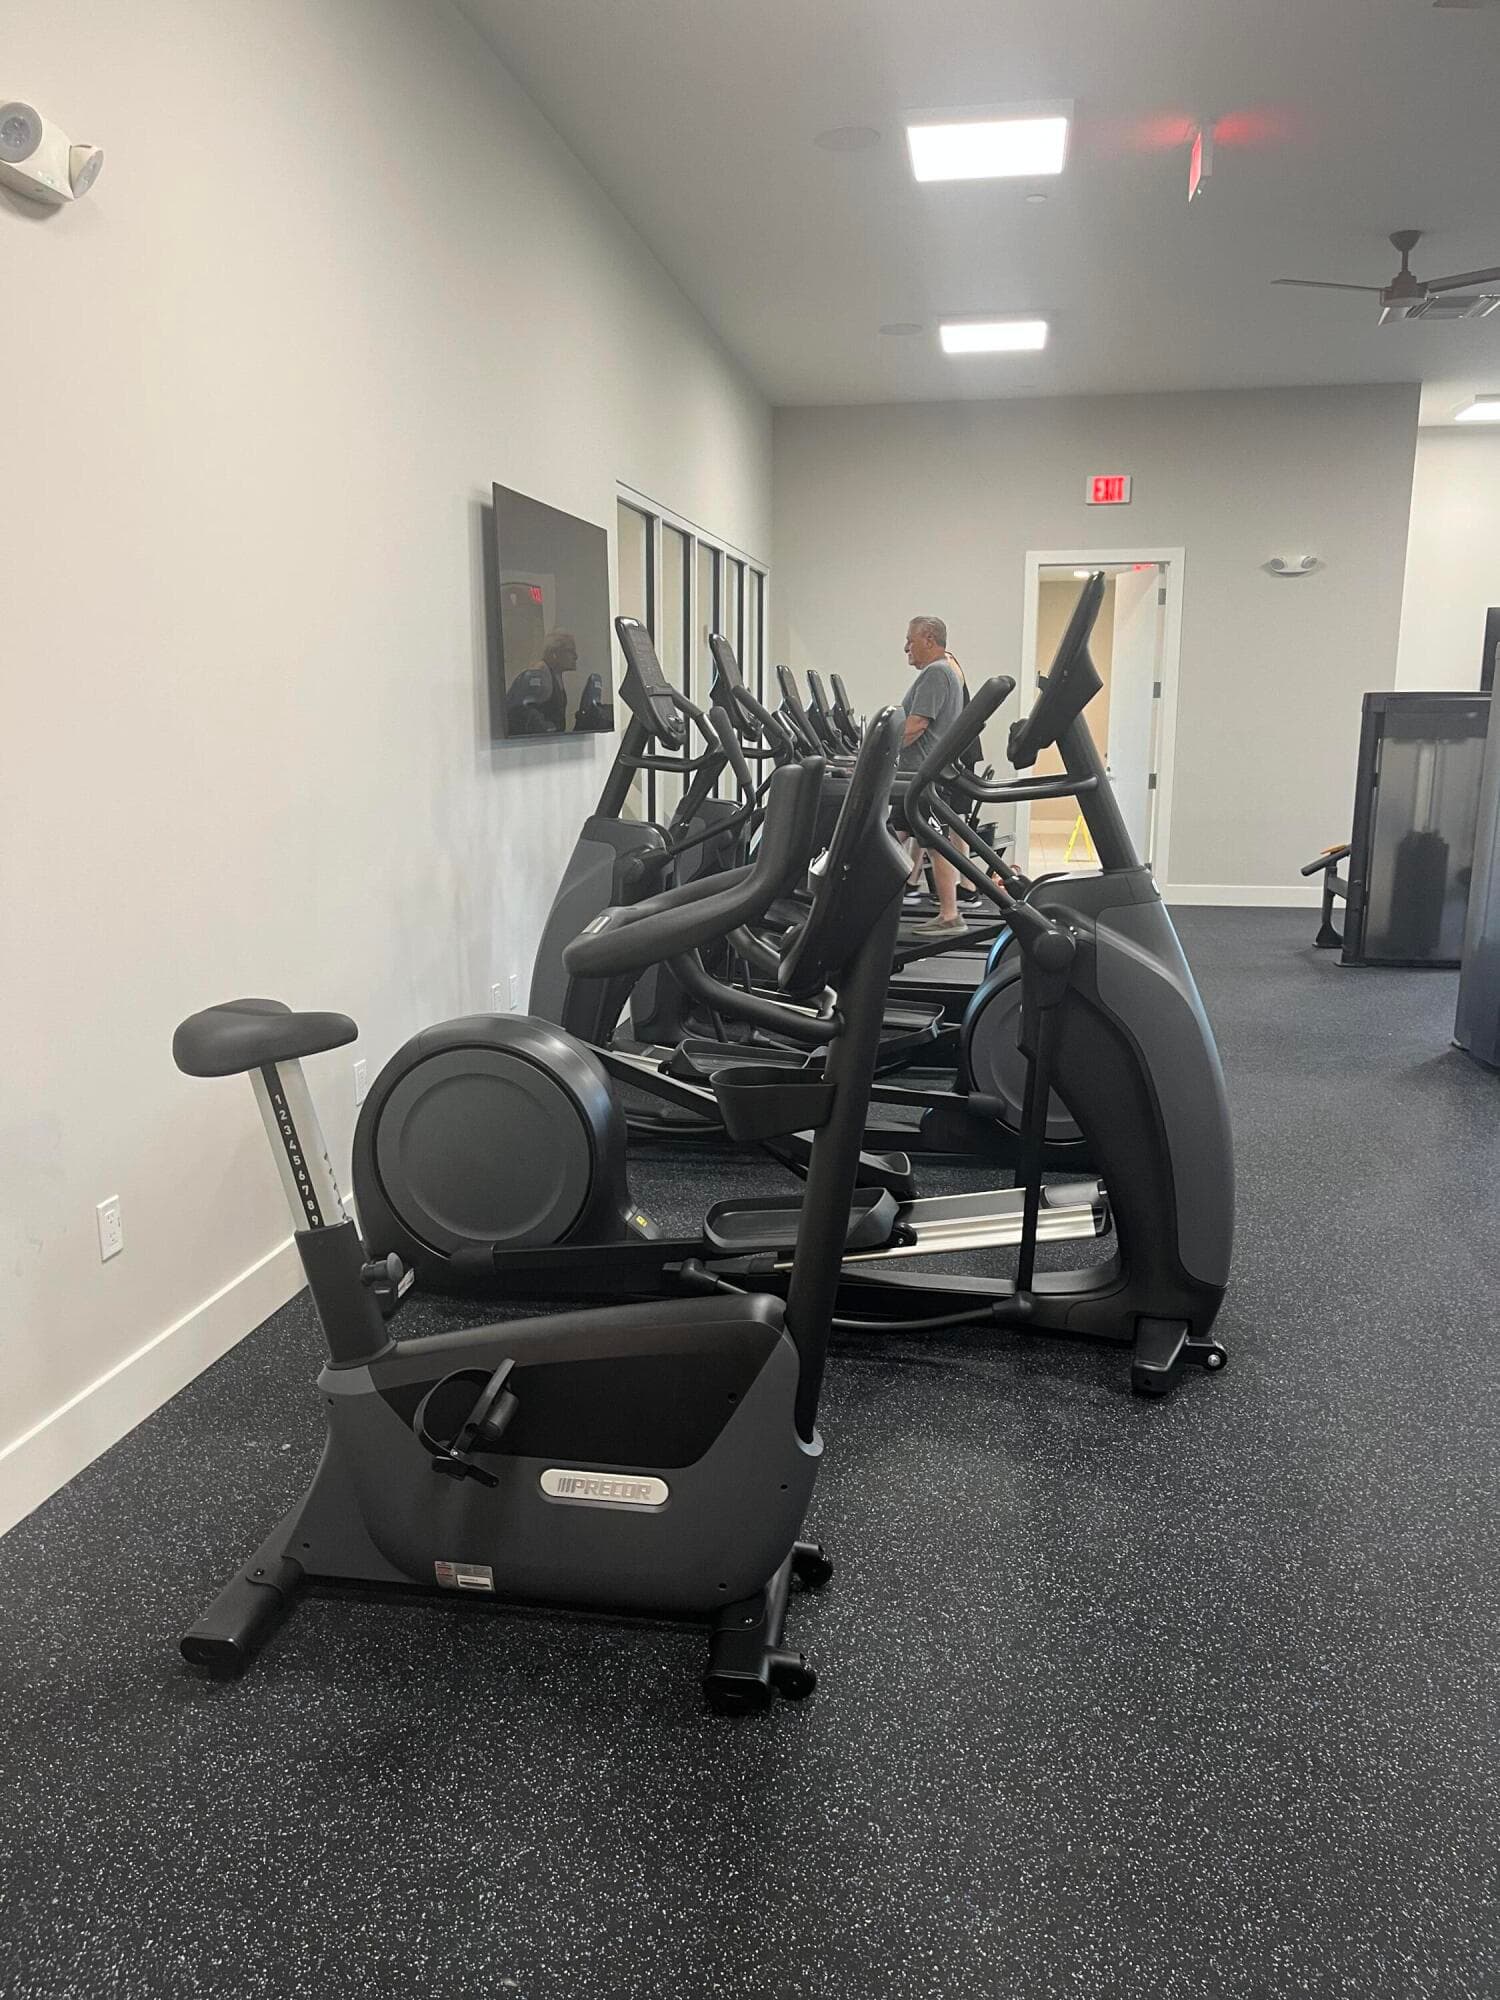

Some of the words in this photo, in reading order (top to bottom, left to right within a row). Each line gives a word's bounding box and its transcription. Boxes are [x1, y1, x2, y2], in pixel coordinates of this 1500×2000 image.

[1094, 477, 1124, 502] EXIT
[275, 1094, 282, 1105] 1
[279, 1110, 288, 1121] 2
[283, 1125, 292, 1135] 3
[289, 1140, 297, 1150] 4
[292, 1155, 301, 1165] 5
[298, 1170, 306, 1181] 6
[302, 1185, 310, 1196] 7
[307, 1200, 315, 1210] 8
[311, 1215, 319, 1225] 9
[570, 1478, 652, 1499] PRECOR
